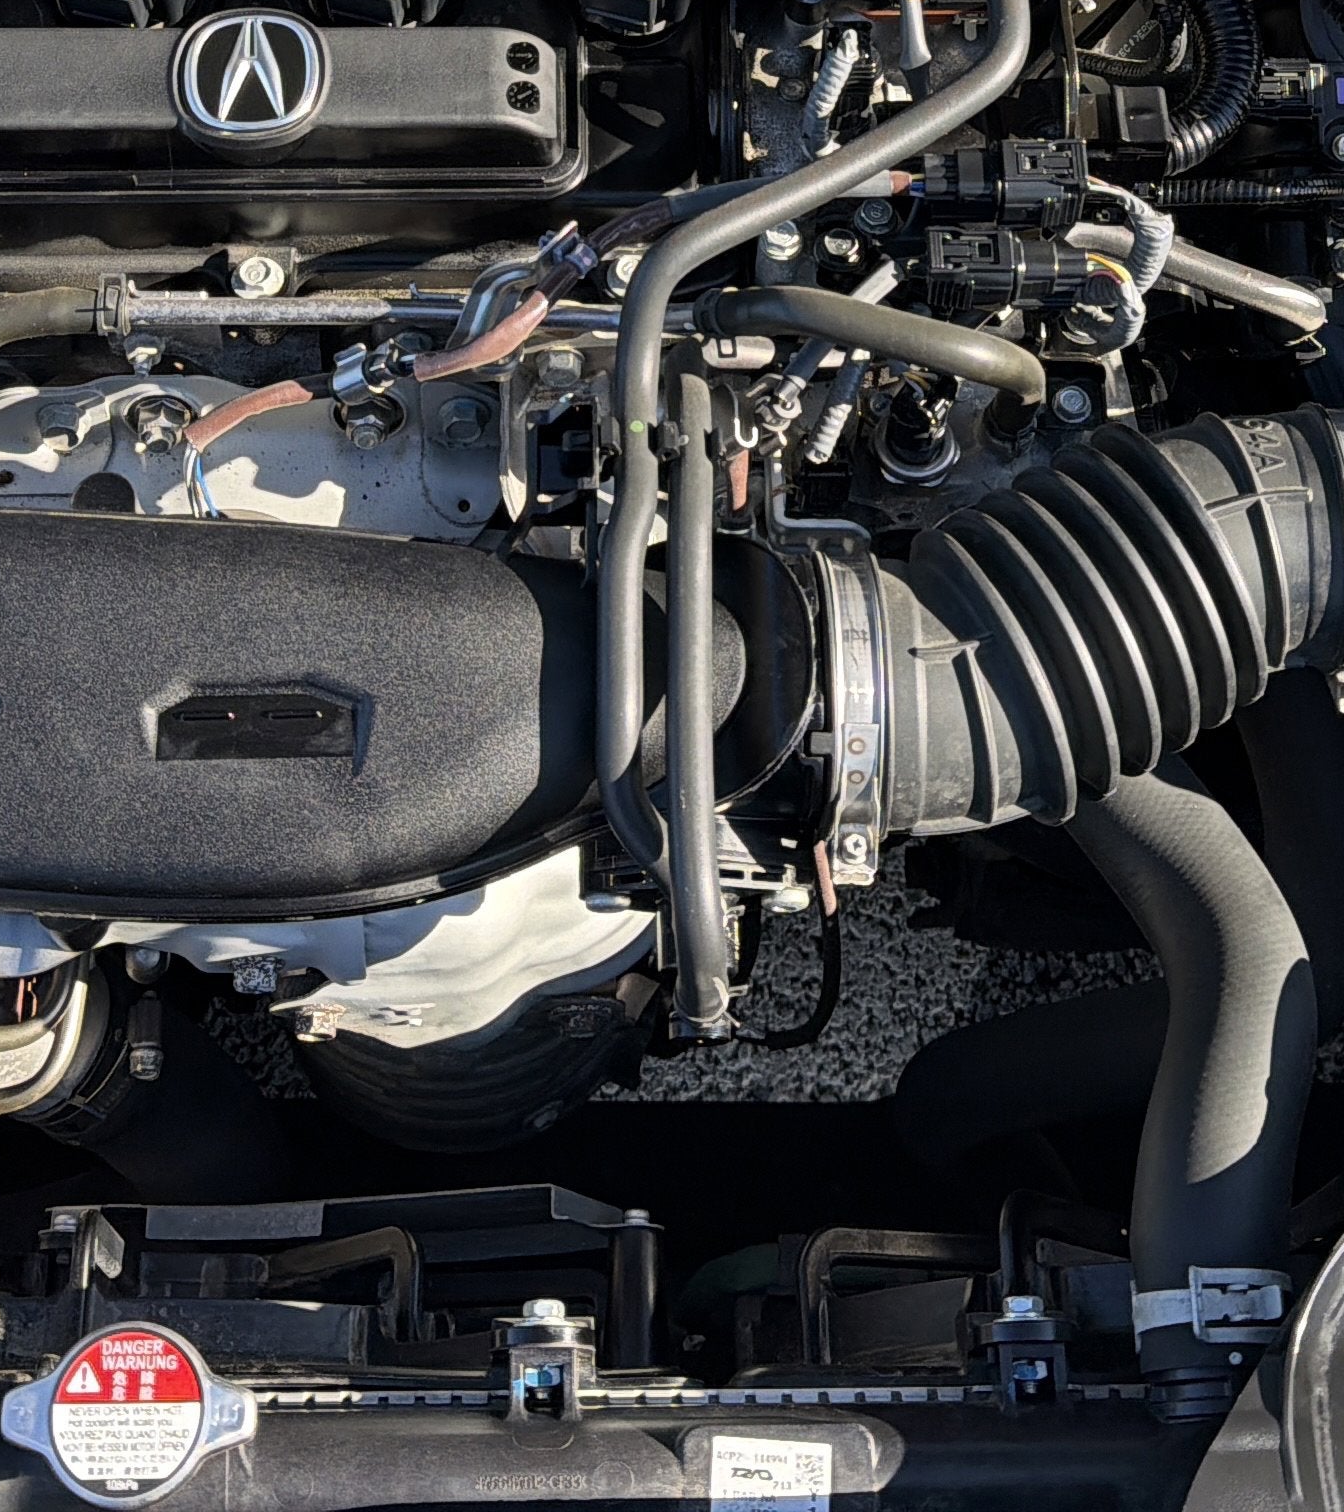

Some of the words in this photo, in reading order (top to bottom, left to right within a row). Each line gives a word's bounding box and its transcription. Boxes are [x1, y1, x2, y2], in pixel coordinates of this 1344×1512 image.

[101, 1339, 164, 1355] DANGER
[102, 1354, 178, 1371] WARNUNG
[69, 1406, 101, 1416] NEVER
[103, 1406, 130, 1416] OPEN
